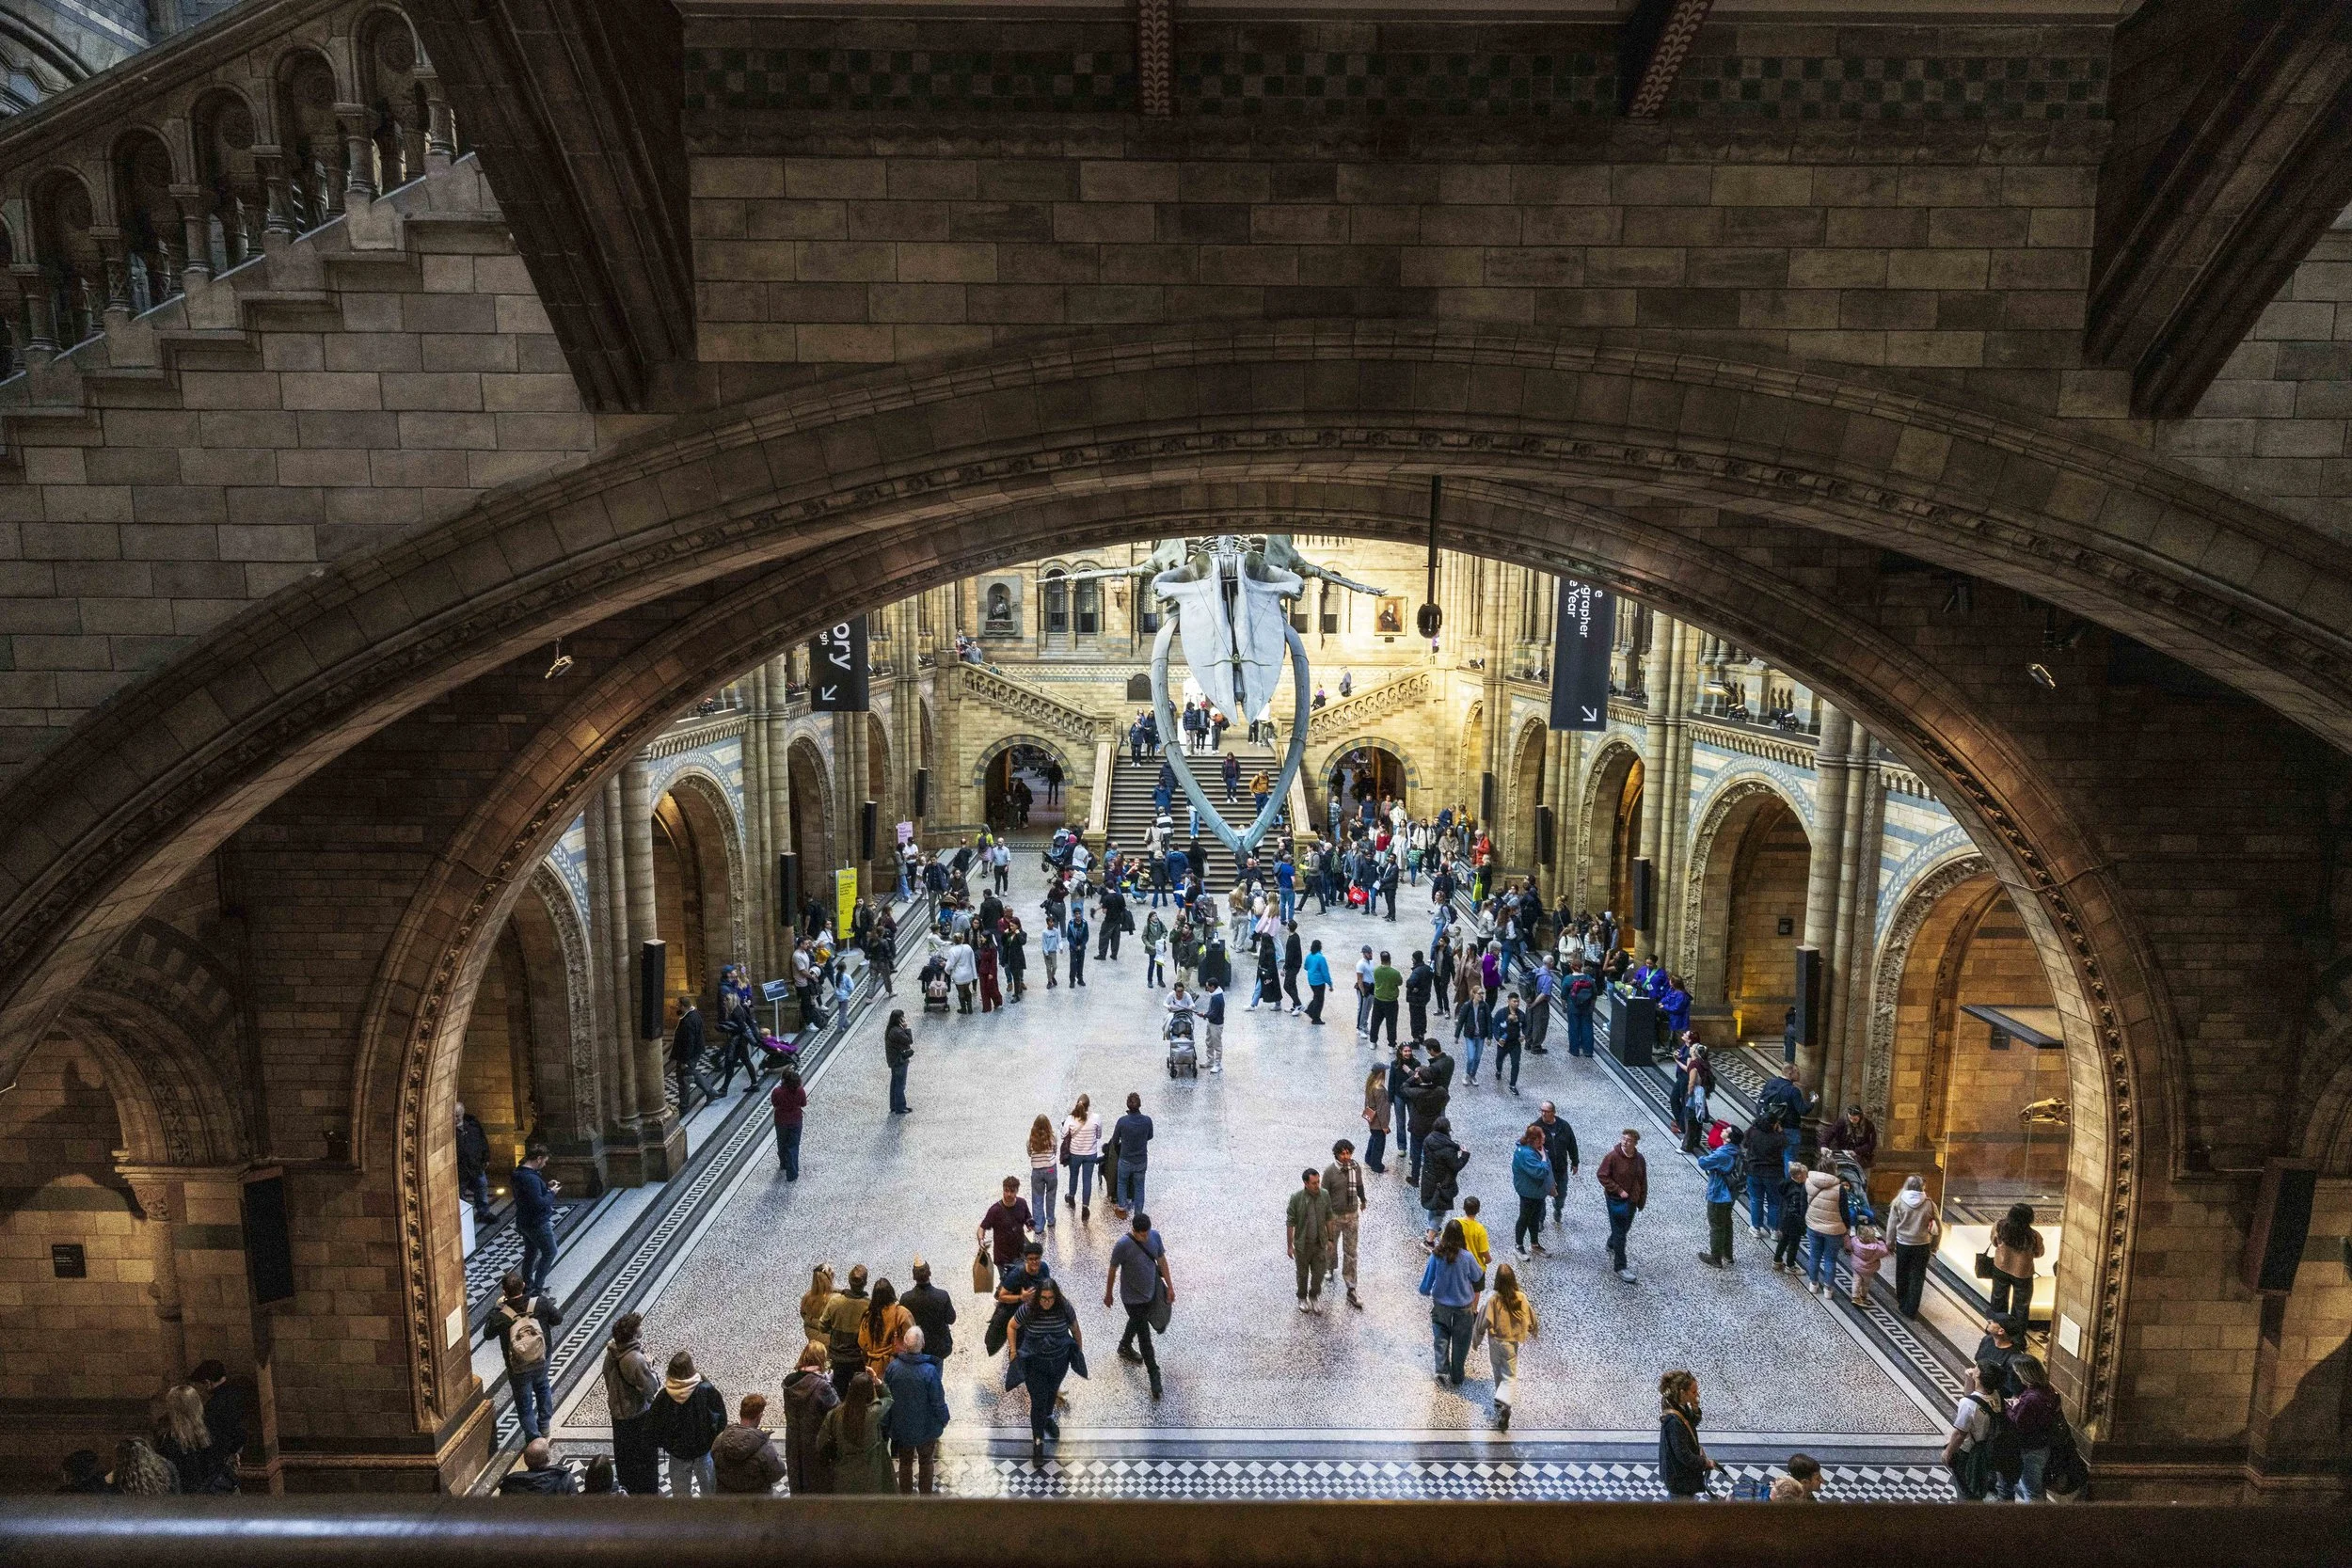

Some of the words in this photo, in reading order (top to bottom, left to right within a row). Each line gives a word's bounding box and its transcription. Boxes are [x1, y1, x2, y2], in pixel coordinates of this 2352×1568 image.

[1567, 588, 1580, 618] Year
[1579, 584, 1591, 638] grapher
[819, 631, 830, 645] gh
[829, 623, 851, 671] ory
